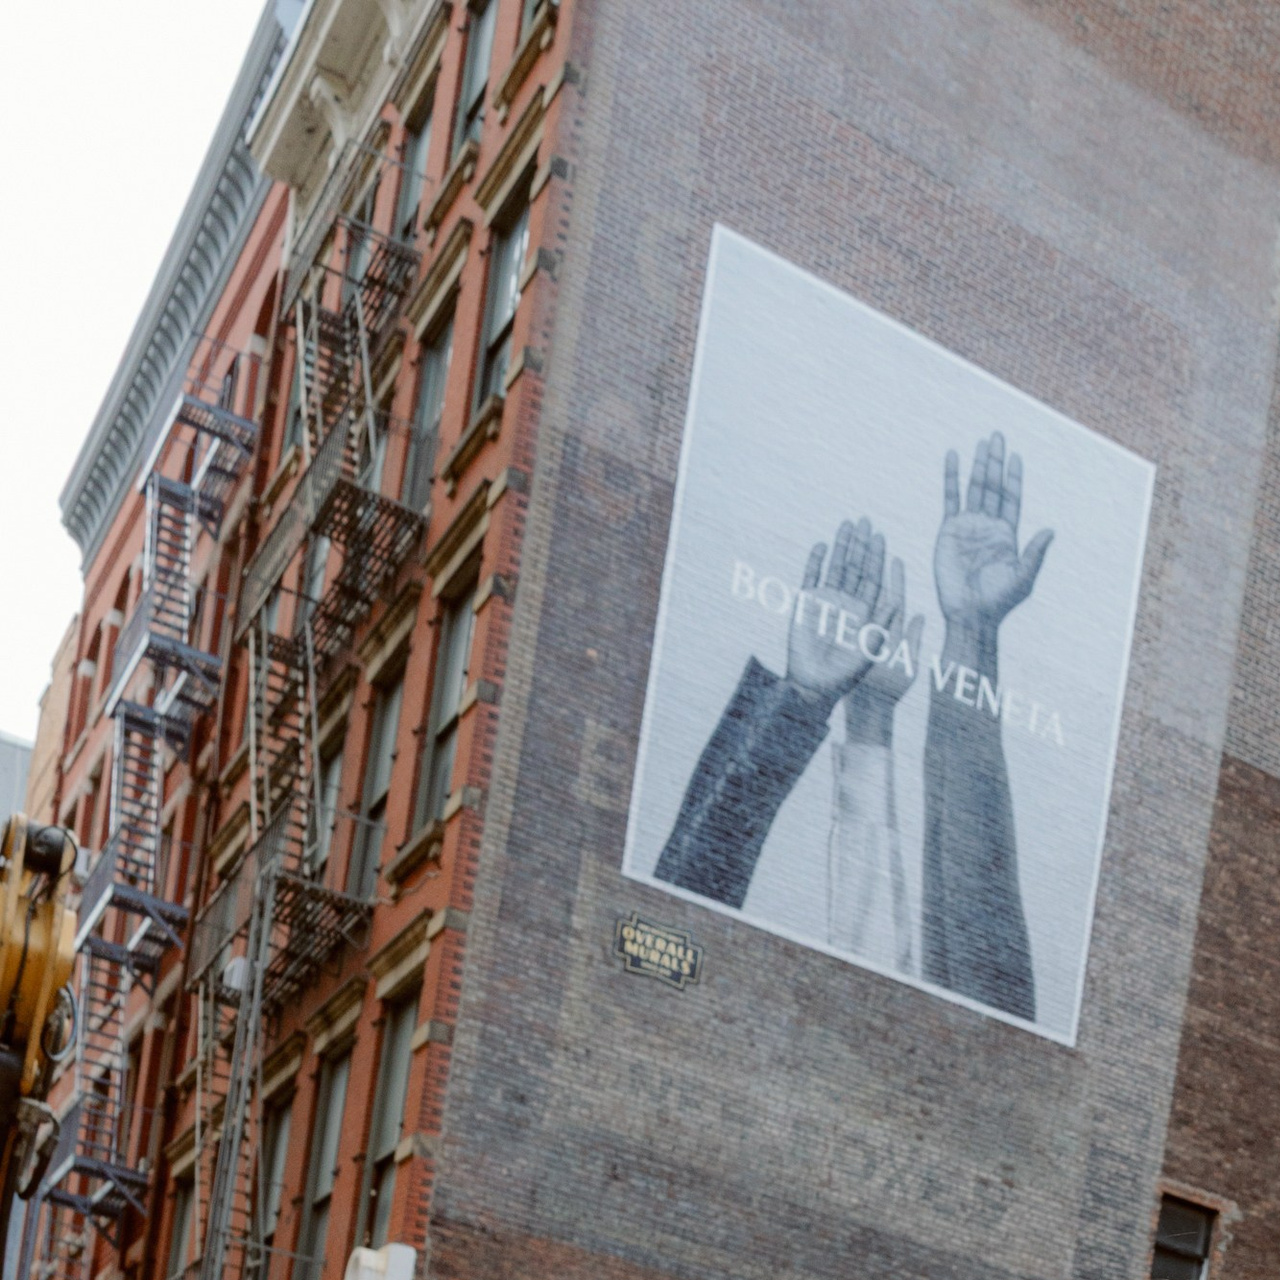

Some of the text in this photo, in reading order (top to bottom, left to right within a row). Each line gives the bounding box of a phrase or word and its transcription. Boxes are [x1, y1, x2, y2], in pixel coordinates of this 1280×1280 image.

[730, 561, 1066, 748] BOTTEGA VENETA
[622, 924, 695, 965] OVERALL
[623, 939, 691, 976] MURALS
